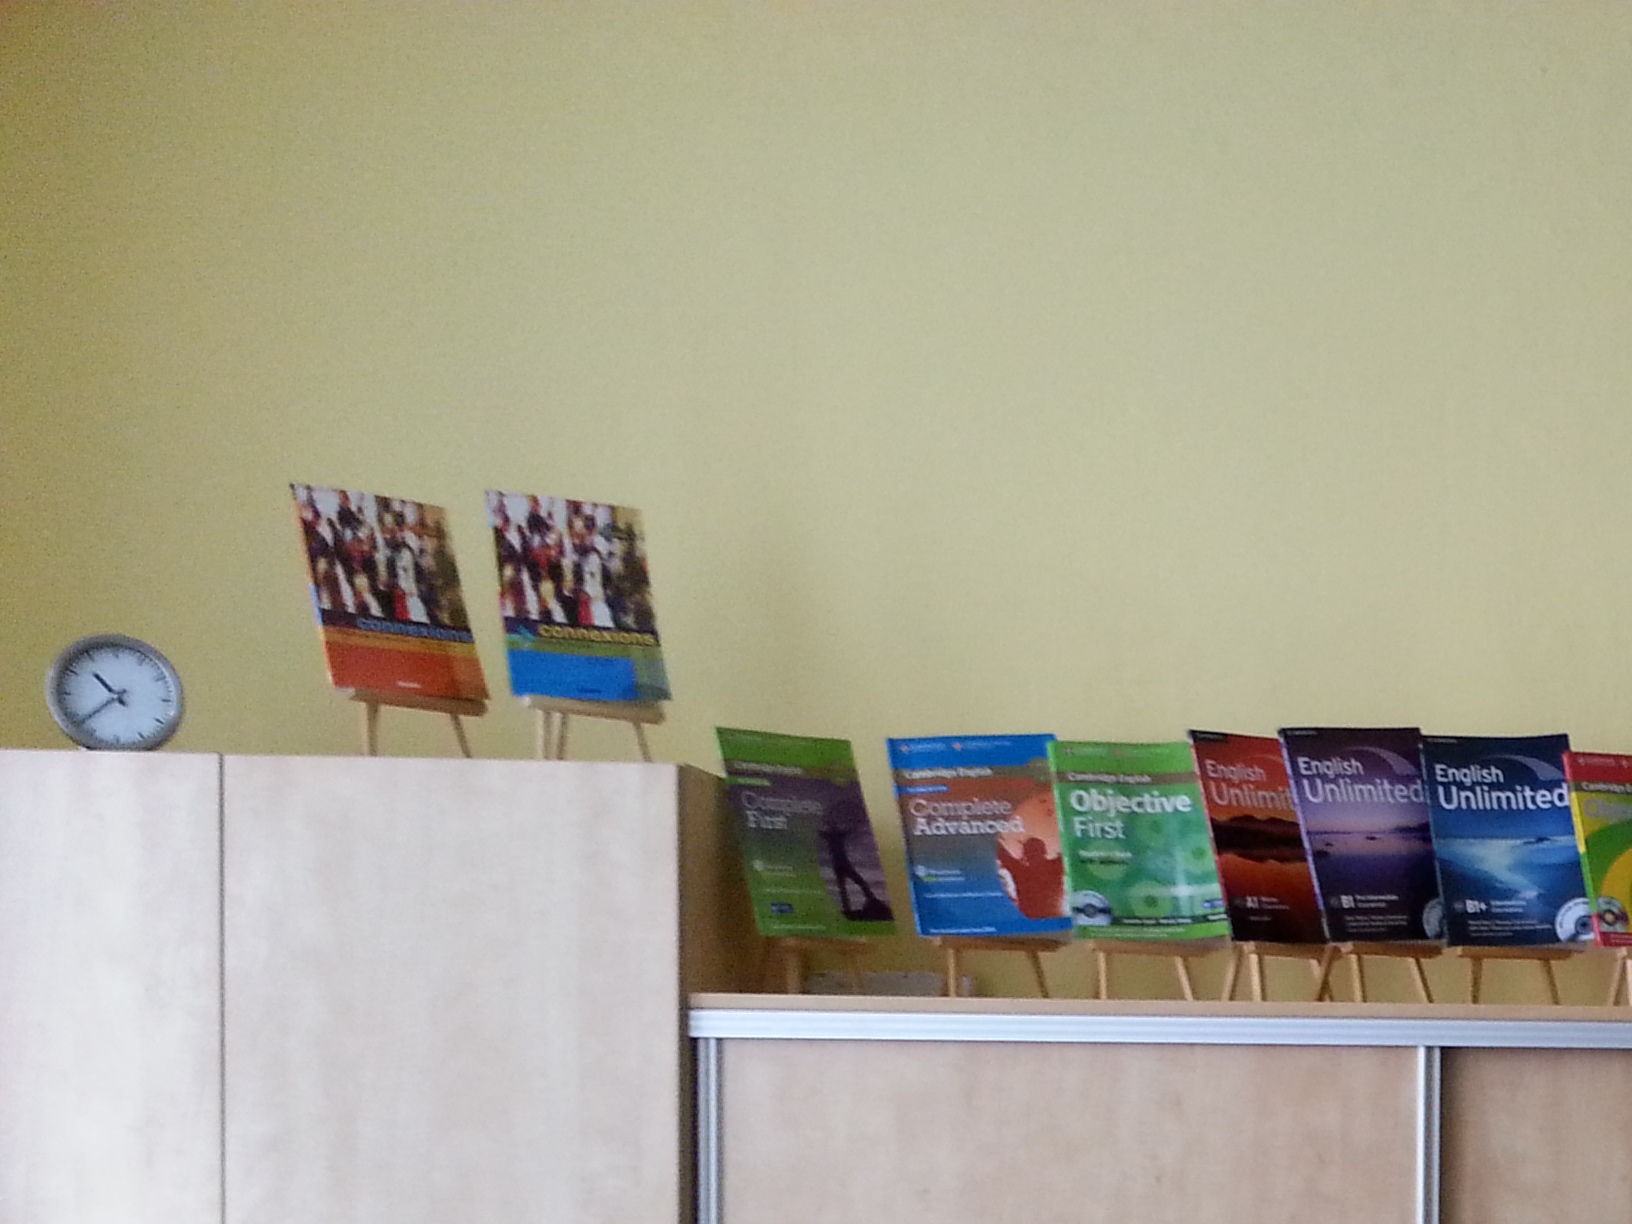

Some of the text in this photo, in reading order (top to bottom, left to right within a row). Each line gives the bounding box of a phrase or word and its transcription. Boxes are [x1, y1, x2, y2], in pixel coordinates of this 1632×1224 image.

[538, 623, 656, 647] connexions
[1203, 758, 1267, 783] English
[1297, 756, 1366, 779] English
[1433, 763, 1506, 787] English
[1069, 787, 1194, 818] Objective
[1301, 778, 1424, 804] Unlimited
[1436, 781, 1571, 811] Unlimited
[910, 797, 1013, 819] Complete
[912, 815, 1026, 837] Advanced
[1073, 816, 1127, 840] First
[1464, 899, 1488, 914] B1+
